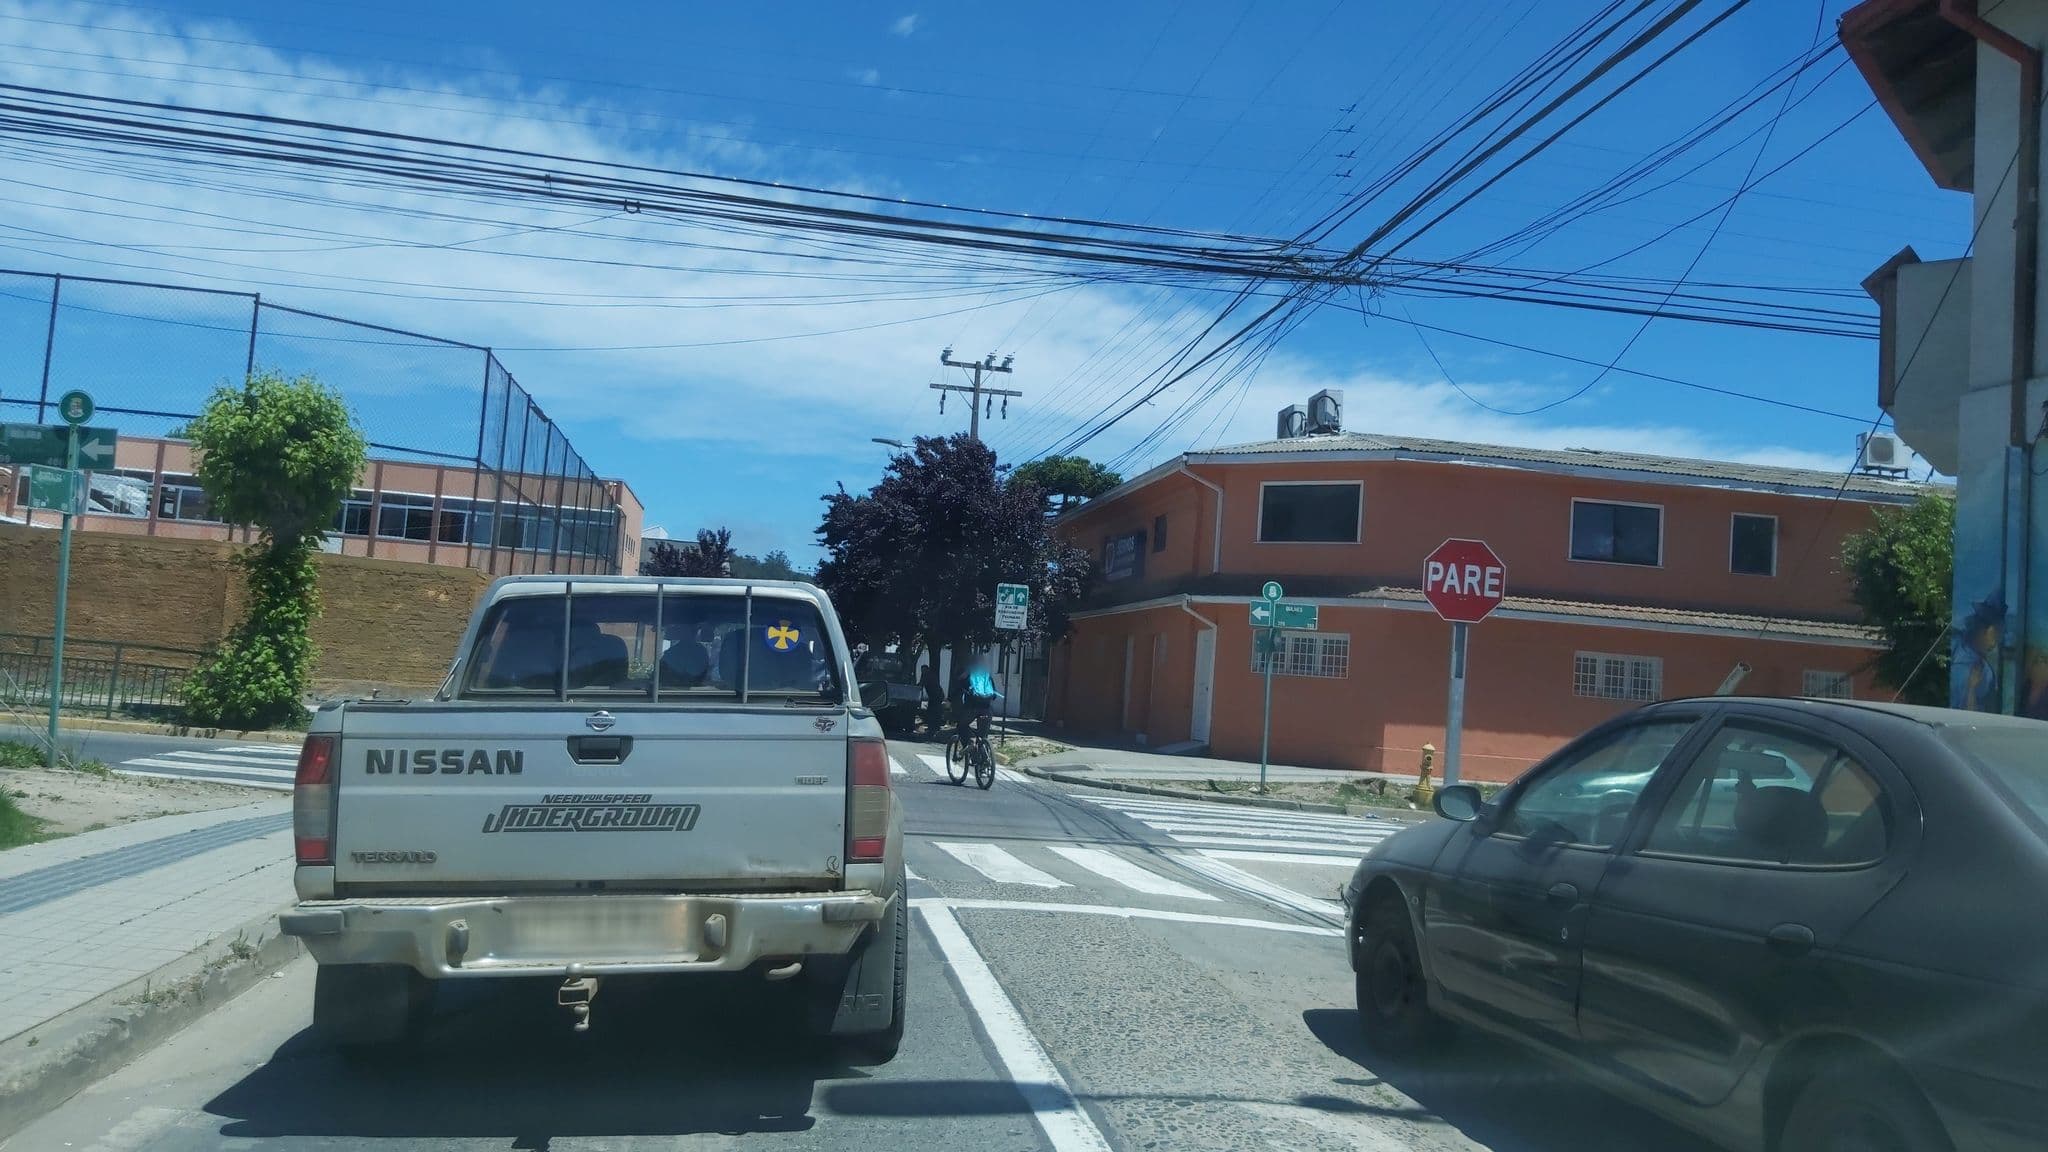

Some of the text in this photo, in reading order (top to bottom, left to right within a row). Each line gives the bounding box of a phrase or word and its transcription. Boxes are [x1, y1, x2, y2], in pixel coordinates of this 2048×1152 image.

[1427, 561, 1501, 598] PARE
[366, 749, 524, 775] NISSAN
[541, 794, 585, 804] NEED
[602, 793, 653, 804] SPEED
[482, 804, 701, 833] UNDERGROUND
